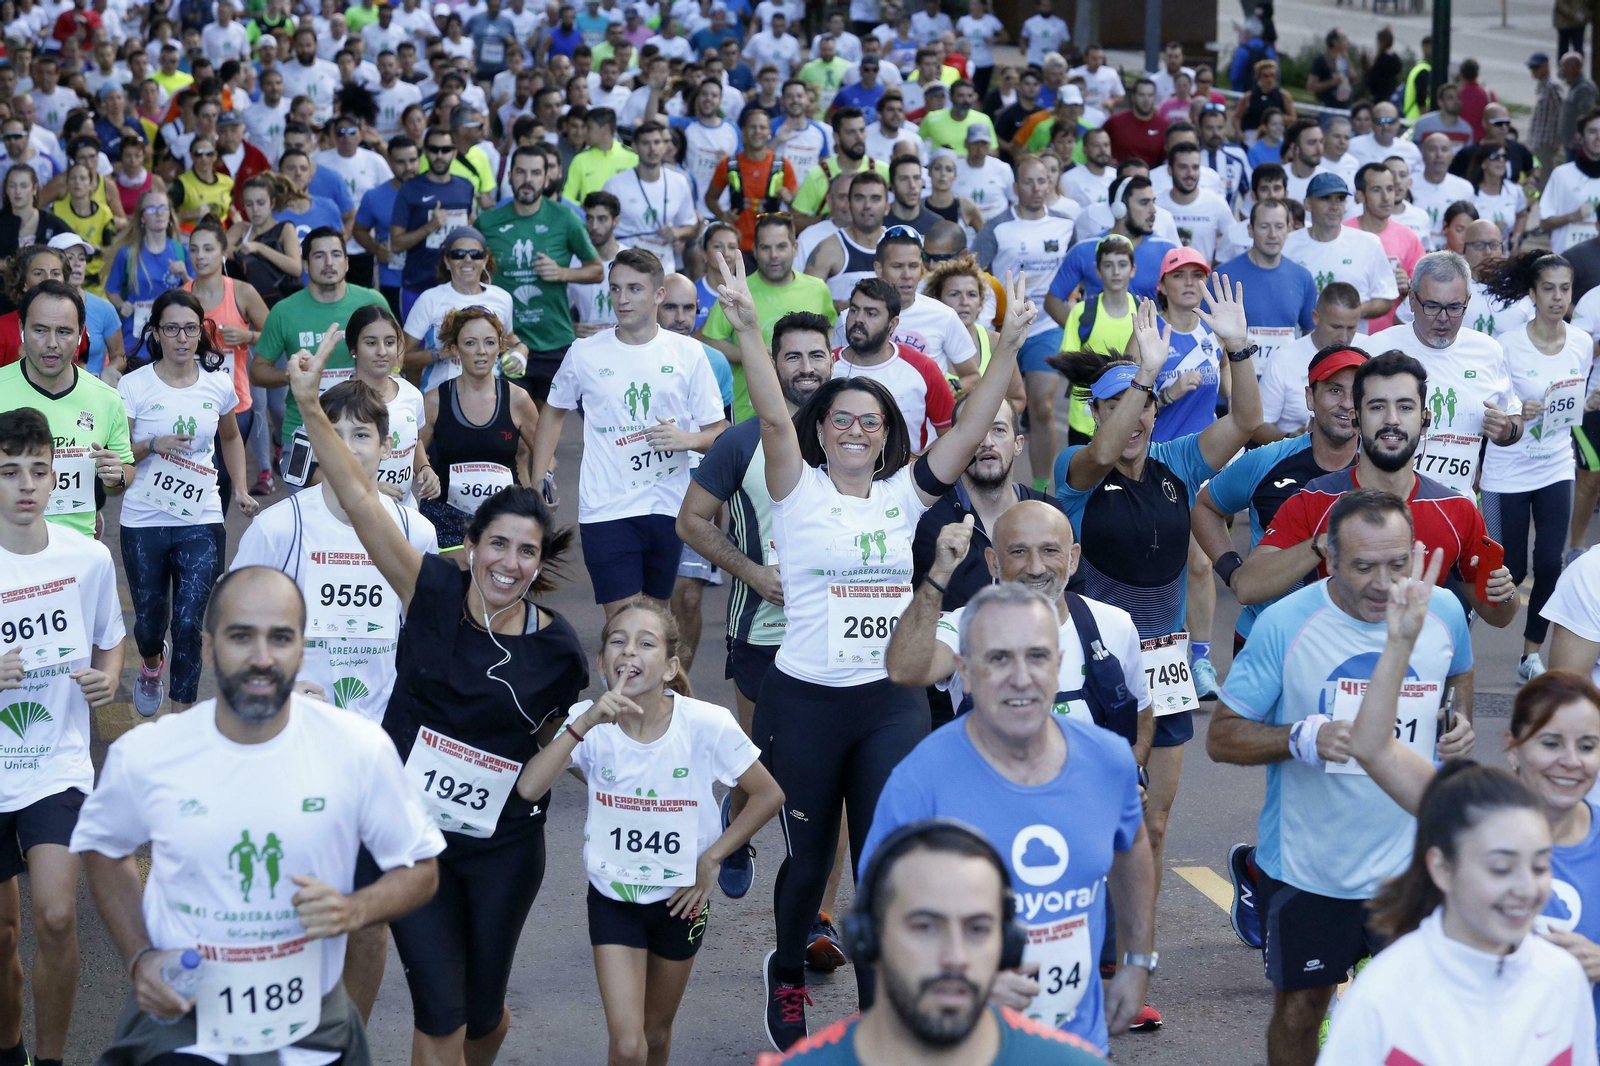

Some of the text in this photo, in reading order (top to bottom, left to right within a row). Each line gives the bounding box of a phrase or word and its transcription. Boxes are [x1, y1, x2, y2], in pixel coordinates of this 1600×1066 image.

[905, 335, 926, 353] ELA
[452, 465, 463, 474] 41
[1414, 454, 1471, 476] 17756
[52, 471, 81, 490] 51
[153, 471, 204, 503] 18781
[311, 552, 366, 564] 41 CARRERA
[842, 568, 880, 576] CARRERA
[1, 576, 76, 599] CARRERA URBANA
[320, 584, 382, 607] 9556
[830, 586, 848, 598] 41
[1, 609, 68, 644] 9616
[360, 645, 390, 654] URBANA
[1144, 662, 1188, 690] 7496
[1341, 681, 1358, 695] 41
[422, 730, 518, 772] 41 CARRERA URBANA
[438, 745, 462, 760] CIUDAD
[464, 756, 472, 764] DE
[424, 770, 490, 810] 1923
[596, 791, 614, 807] 41
[614, 796, 658, 806] CARRERA
[615, 802, 641, 812] CIUDAD
[610, 827, 680, 854] 1846
[213, 910, 272, 922] CARRERA
[218, 976, 303, 1014] 1188
